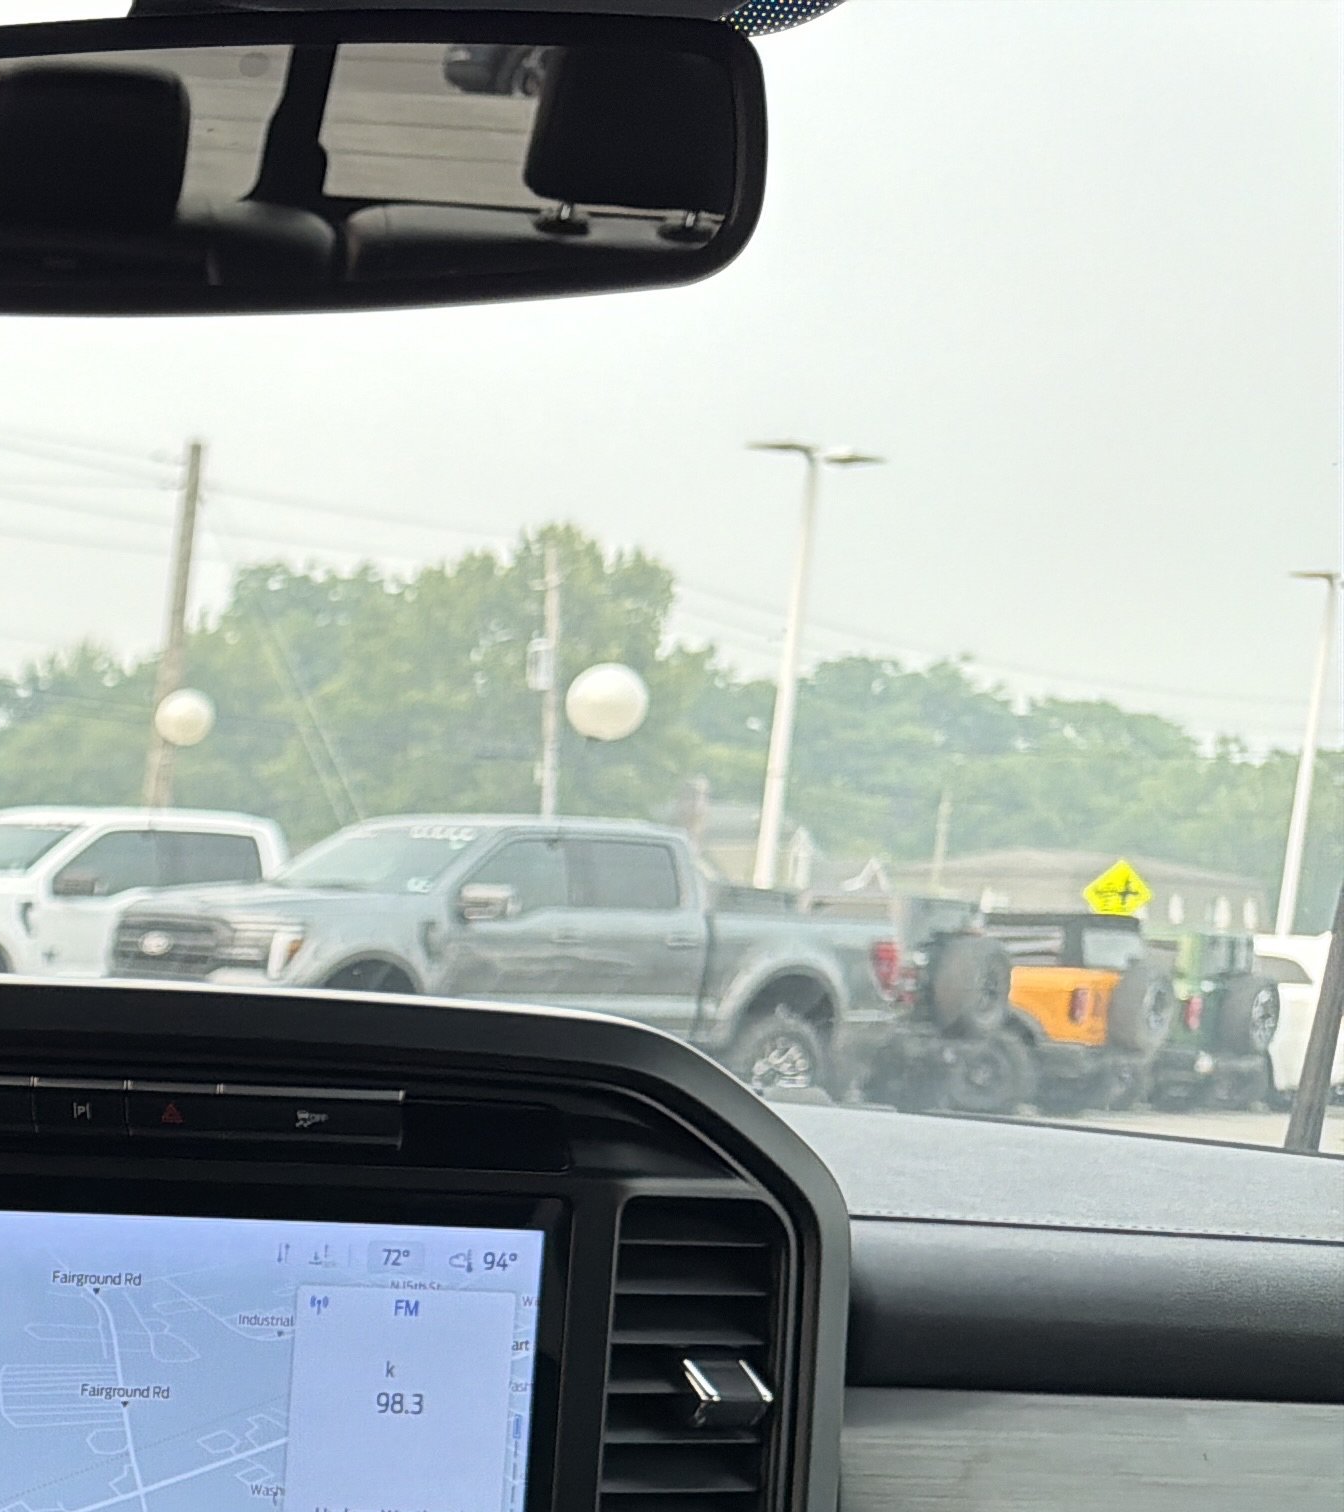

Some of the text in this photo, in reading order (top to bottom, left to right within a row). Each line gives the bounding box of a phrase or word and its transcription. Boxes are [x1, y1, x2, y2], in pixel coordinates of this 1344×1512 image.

[52, 1270, 142, 1288] Fairground Rd
[394, 1299, 420, 1317] FM
[238, 1313, 295, 1328] Industrial
[385, 1361, 395, 1378] k
[80, 1383, 170, 1400] Fairground Rd
[376, 1391, 424, 1415] 98.3
